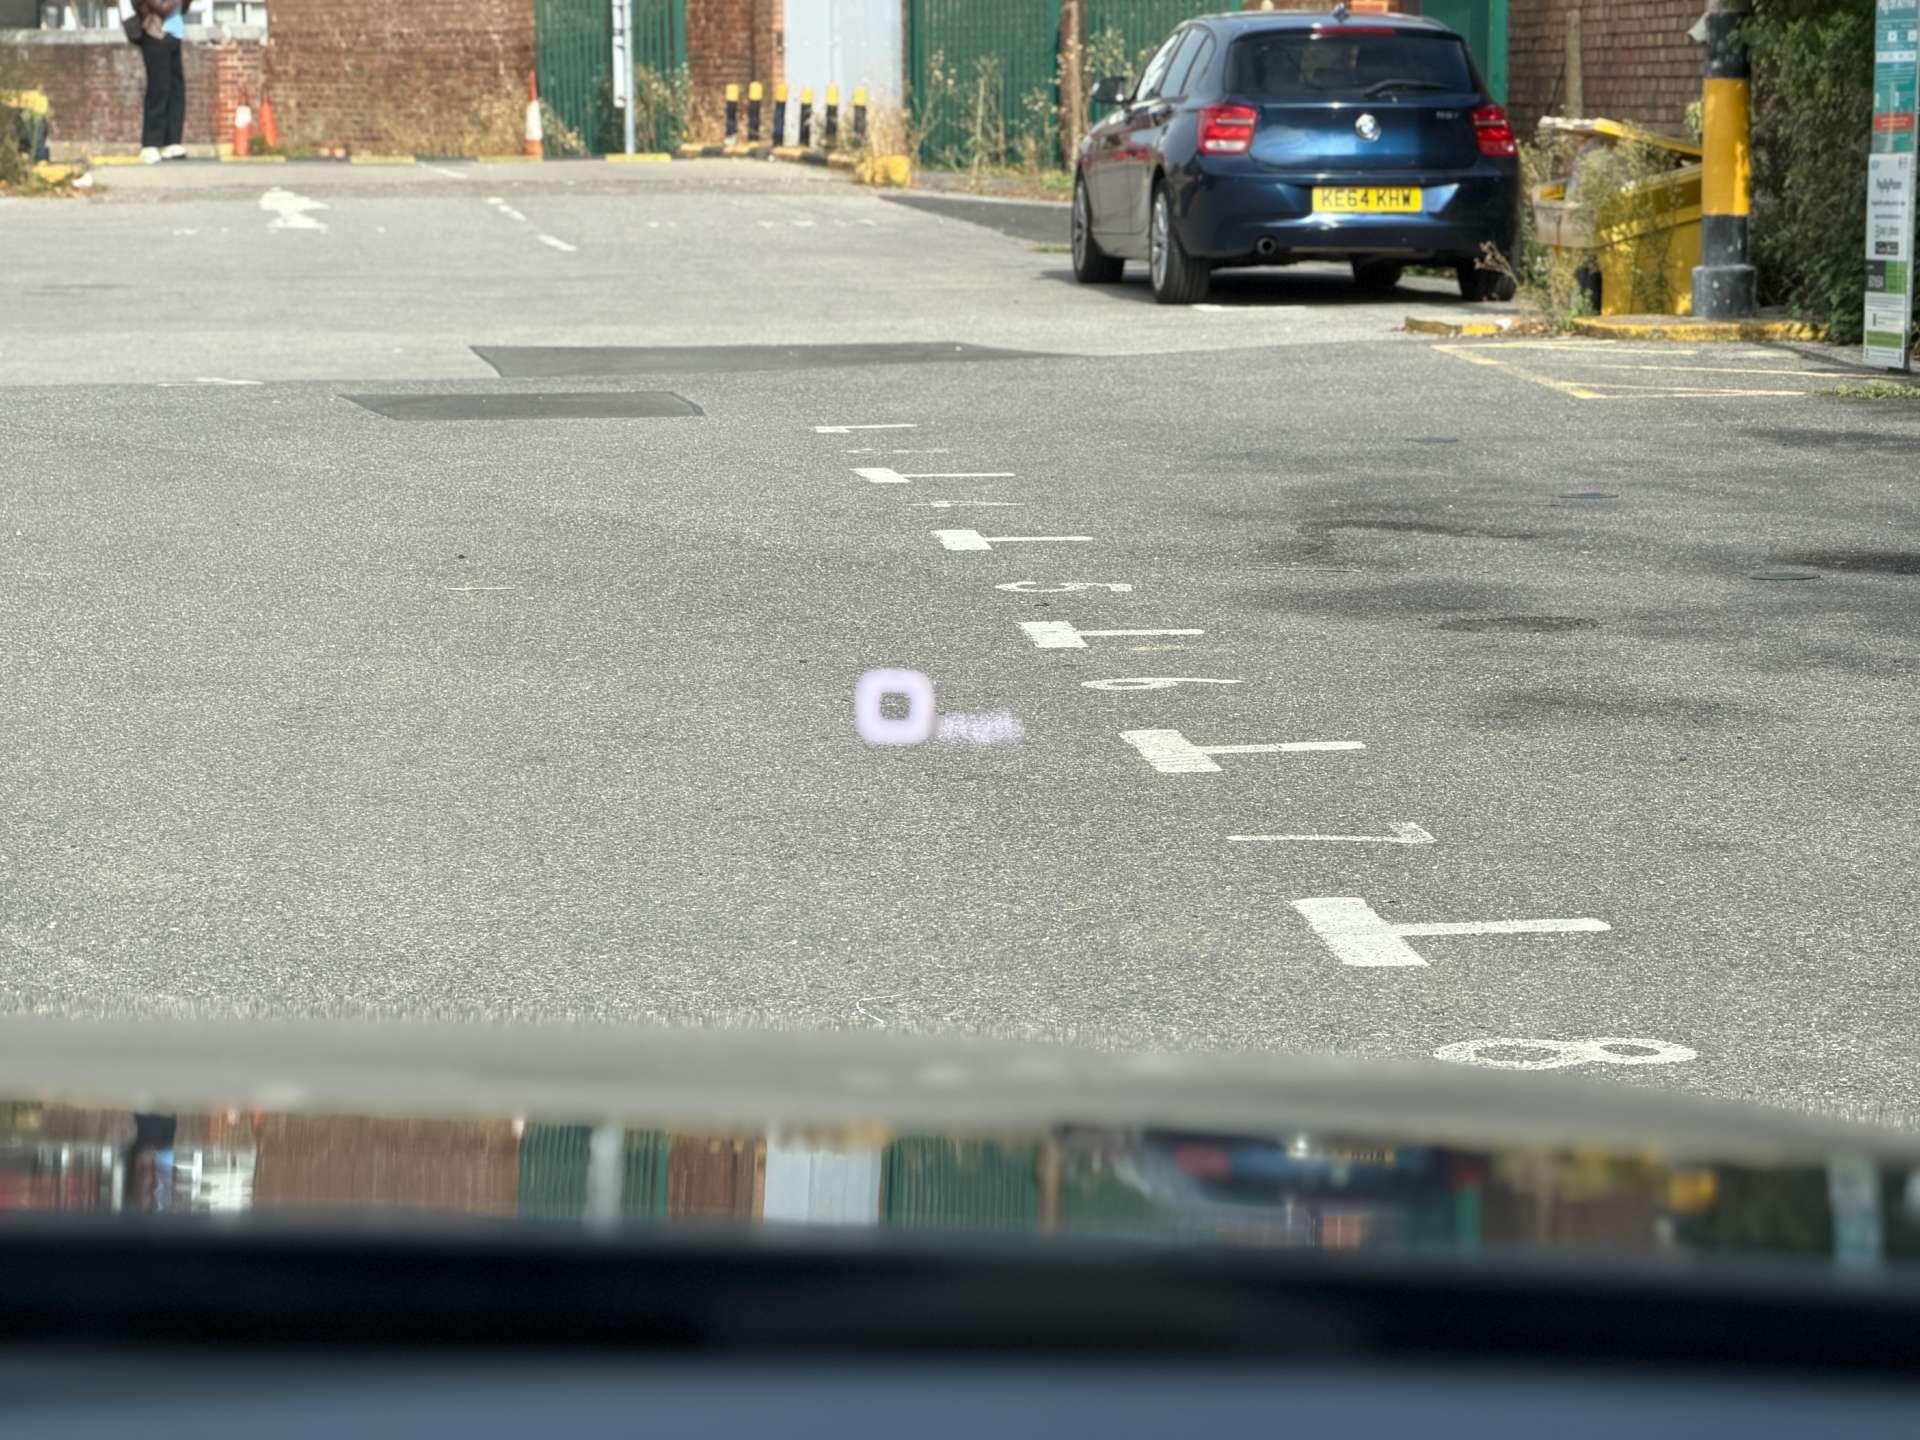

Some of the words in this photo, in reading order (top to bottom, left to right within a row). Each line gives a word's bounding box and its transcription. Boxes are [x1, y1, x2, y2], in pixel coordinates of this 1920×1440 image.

[1321, 186, 1370, 207] KE64
[1376, 186, 1412, 207] KHW
[995, 581, 1133, 593] 5
[1080, 677, 1245, 691] 6
[854, 667, 935, 745] 0
[1432, 1037, 1699, 1070] 8
